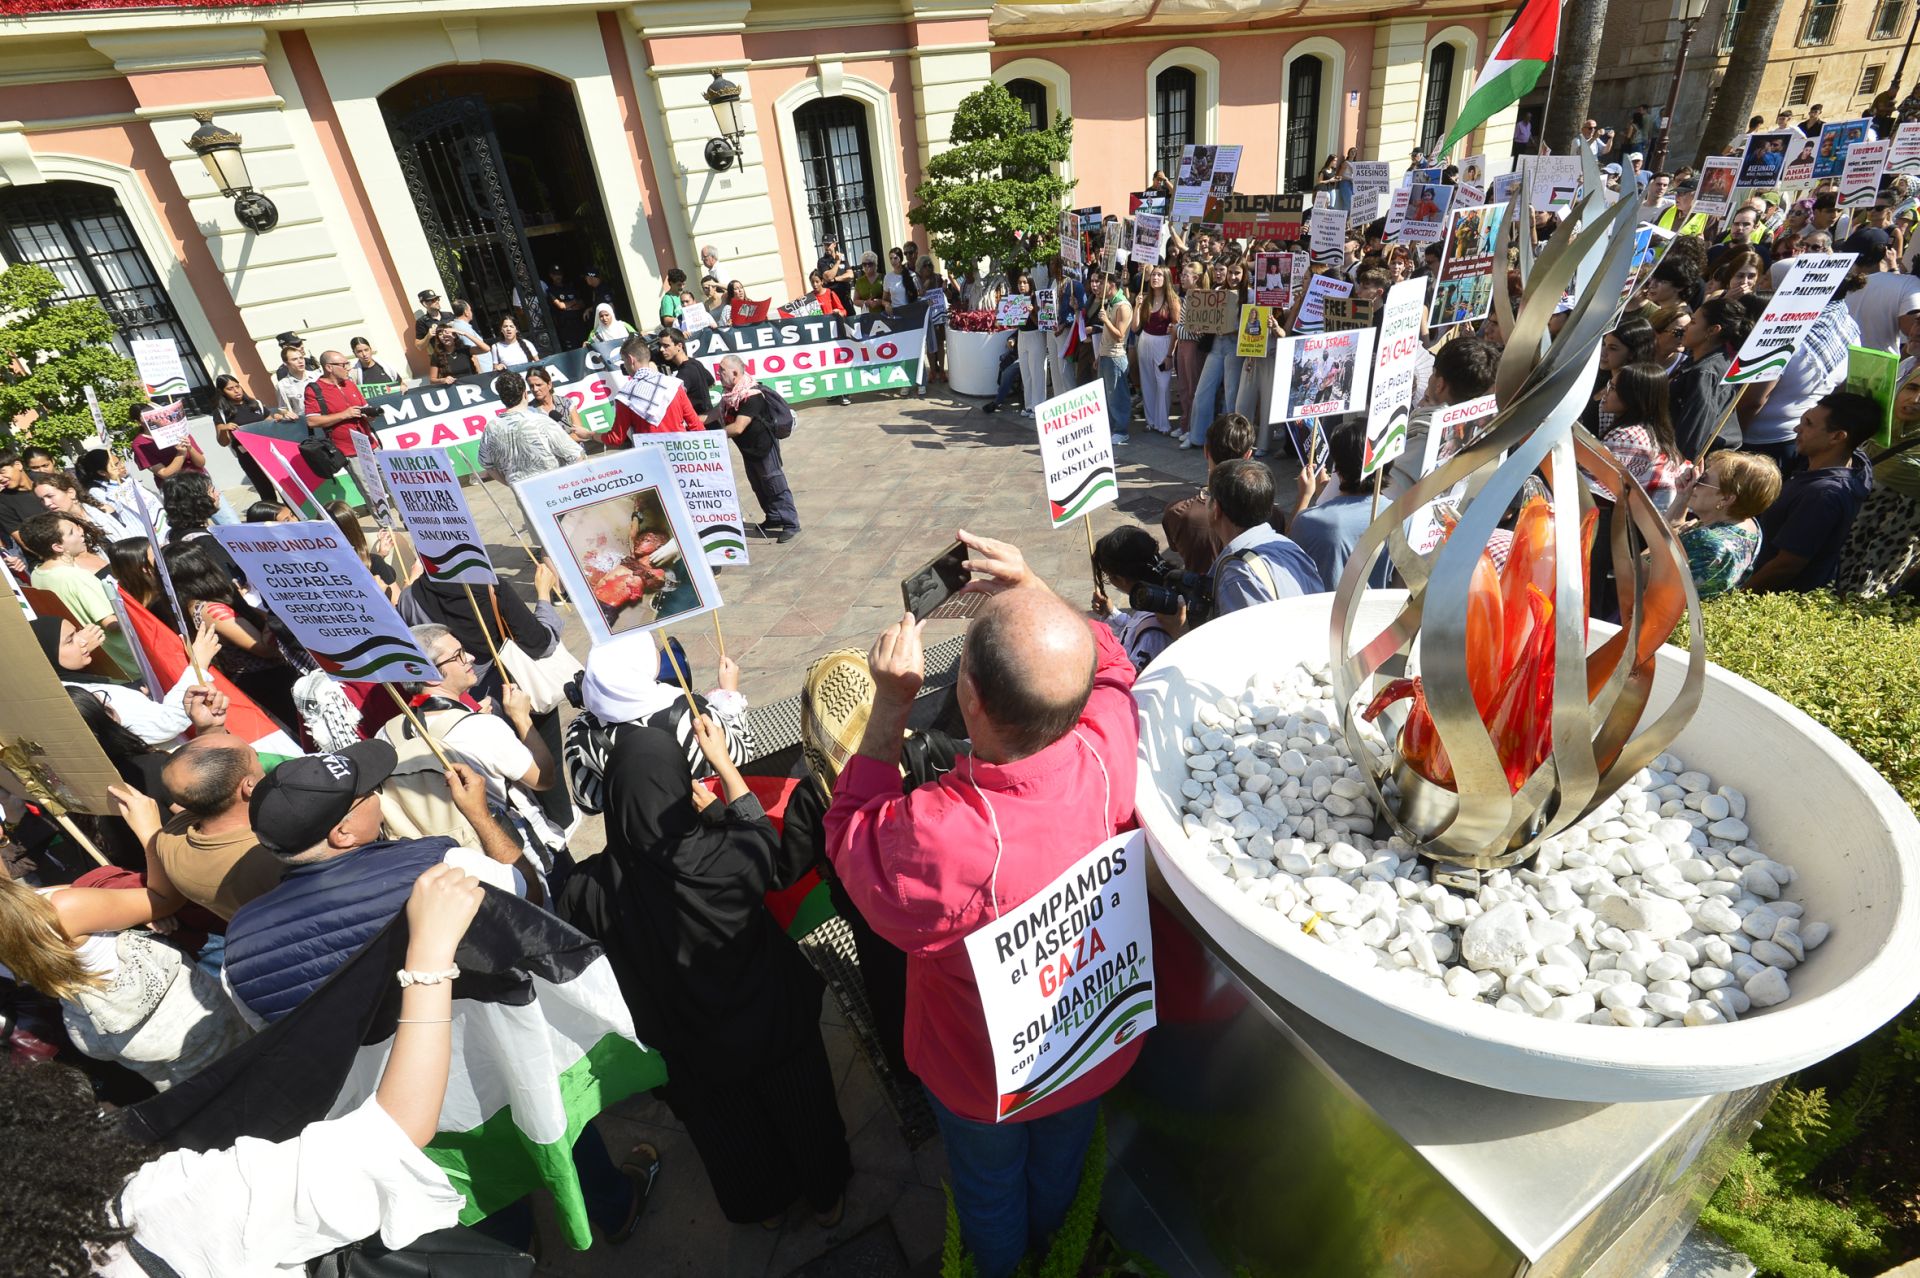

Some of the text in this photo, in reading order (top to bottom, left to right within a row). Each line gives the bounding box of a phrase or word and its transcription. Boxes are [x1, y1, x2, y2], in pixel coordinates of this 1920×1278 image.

[1852, 146, 1884, 155] LIBERTAD
[1356, 169, 1388, 178] ASESINOS
[1786, 167, 1812, 176] AHMA
[1214, 185, 1228, 193] FREE
[1794, 259, 1807, 269] NO
[1817, 258, 1852, 269] LIMPIEZA
[1801, 270, 1830, 283] ÉTNICA
[1316, 279, 1348, 293] LIBERTAD
[1791, 285, 1836, 297] PALESTINOS
[1191, 290, 1227, 308] STOP
[1324, 298, 1347, 318] FREE
[1763, 313, 1776, 322] NO
[1780, 311, 1820, 323] GENOCIDIO
[1772, 324, 1803, 336] PUEBLO
[685, 319, 894, 360] PALESTINA
[1325, 335, 1351, 350] ISRAEL
[1755, 337, 1795, 348] PALESTINO
[1380, 335, 1420, 367] EN GAZA
[361, 383, 387, 399] FREE
[1042, 390, 1099, 422] CARTAGENA
[1300, 401, 1339, 416] GENOCIDIO
[1043, 401, 1101, 435] PALESTINA
[1056, 423, 1096, 448] SIEMPRE
[705, 439, 720, 450] EL
[1061, 440, 1094, 461] CON LA
[389, 455, 440, 471] MURCIA
[1050, 449, 1110, 485] RESISTENCIA
[391, 470, 453, 485] PALESTINA
[557, 484, 571, 492] NO
[581, 476, 597, 486] UNA
[597, 468, 625, 482] GUERRA
[689, 479, 705, 488] AL
[400, 490, 455, 504] RUPTURA
[546, 472, 645, 509] ES UN GENOCIDIO
[406, 501, 460, 513] RELACIONES
[408, 516, 468, 525] EMBARGO ARMAS
[418, 530, 471, 542] SANCIONES
[226, 536, 339, 554] FIN IMPUNIDAD
[262, 561, 330, 576] CASTIGO
[265, 574, 354, 589] CULPABLES
[269, 587, 369, 602] LIMPIEZA ÉTNICA
[284, 602, 366, 615] GENOCIDIO y
[359, 614, 376, 625] de
[317, 626, 373, 638] GUERRA
[994, 847, 1128, 965] ROMPAMOS
[1011, 892, 1121, 985] el ASEDIO a
[1038, 926, 1107, 999] GAZA
[1012, 940, 1140, 1056] SOLIDARIDAD
[1011, 1053, 1035, 1077] con
[1038, 1041, 1052, 1057] la
